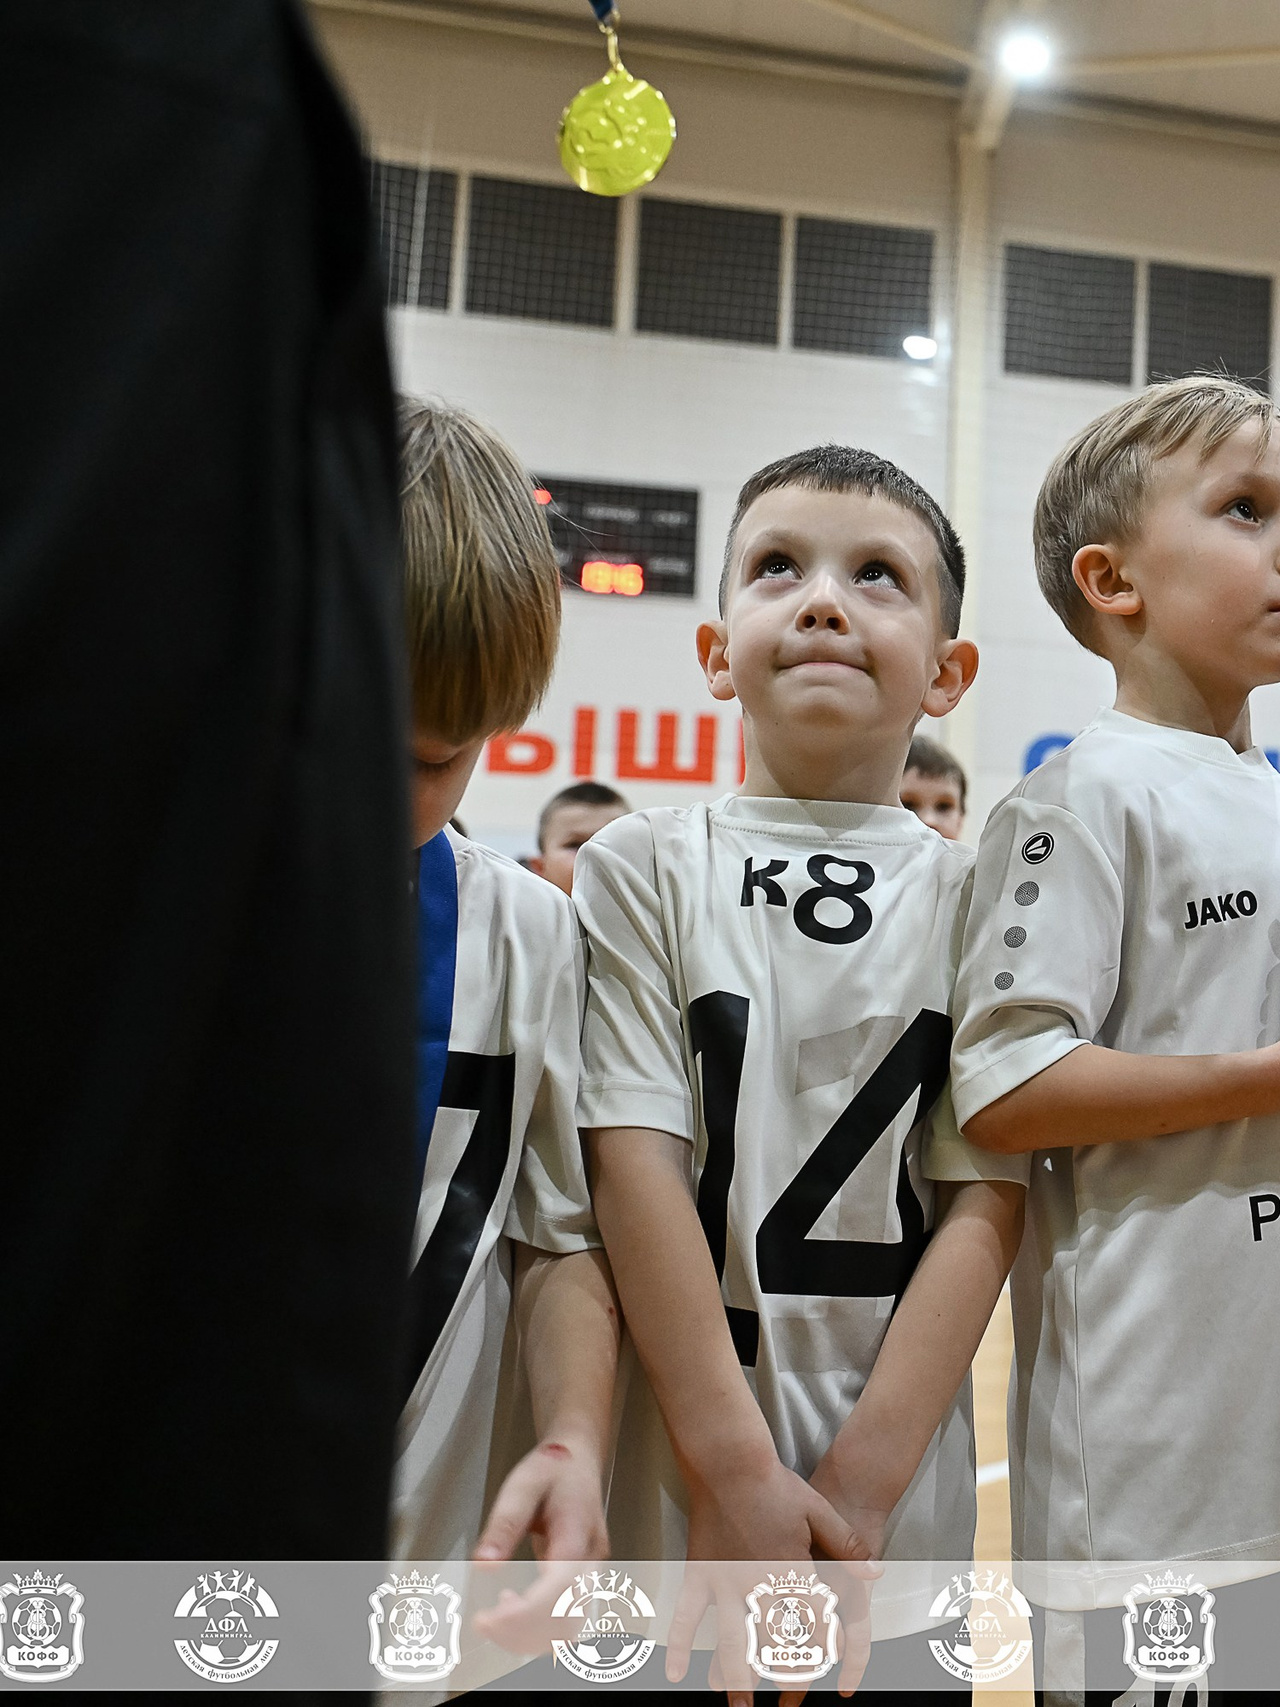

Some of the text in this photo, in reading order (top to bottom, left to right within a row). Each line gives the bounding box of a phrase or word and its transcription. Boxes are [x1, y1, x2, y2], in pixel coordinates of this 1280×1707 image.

[486, 704, 746, 787] ЫШ
[1184, 889, 1258, 931] JAKO
[688, 989, 954, 1369] 14
